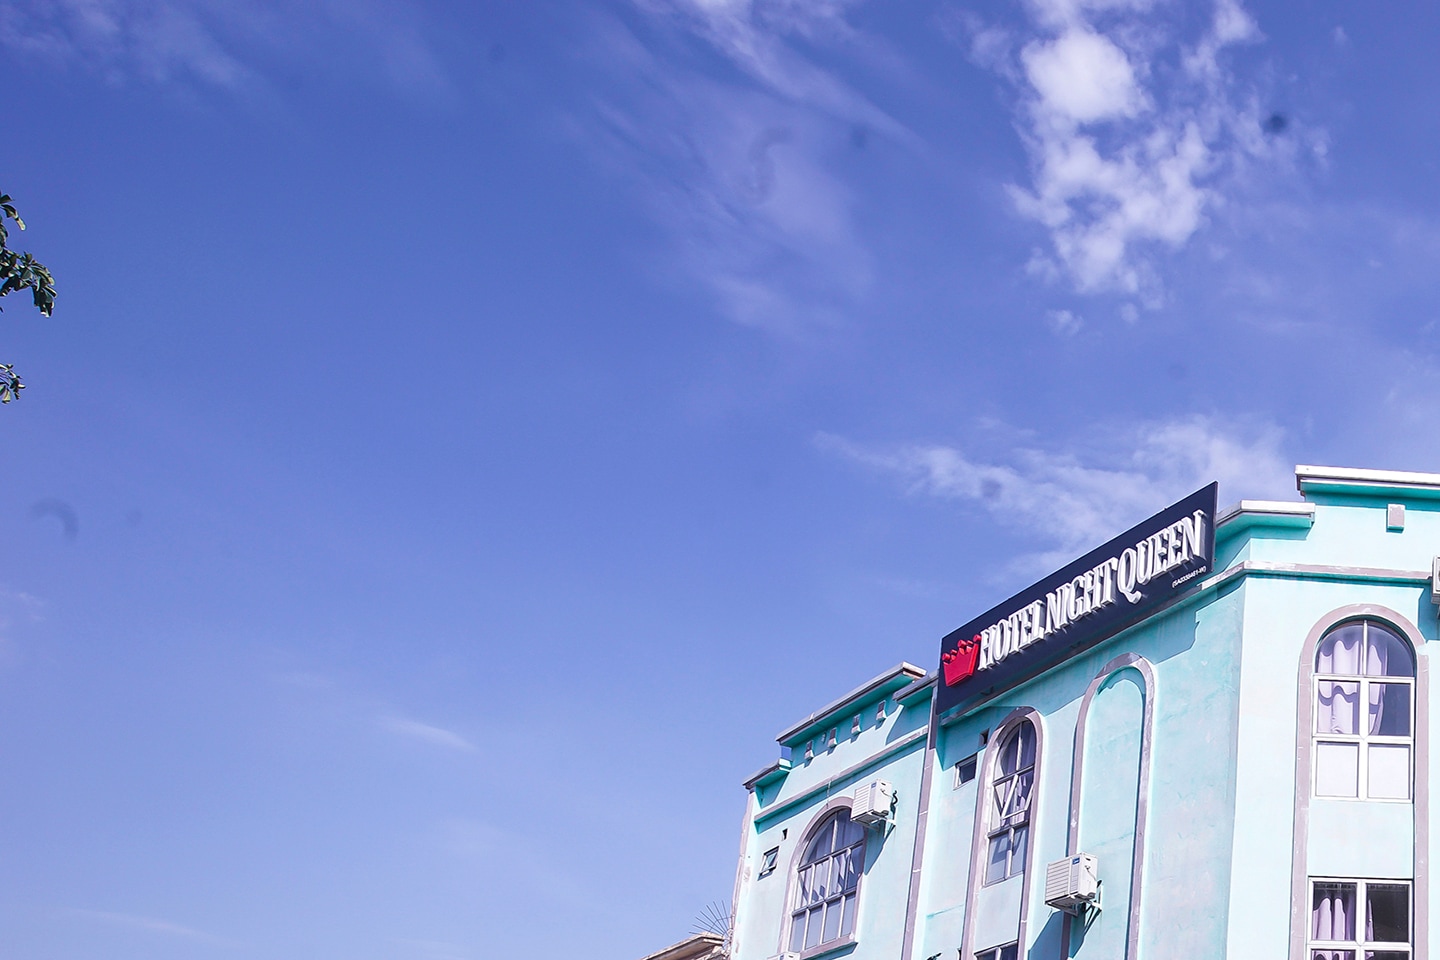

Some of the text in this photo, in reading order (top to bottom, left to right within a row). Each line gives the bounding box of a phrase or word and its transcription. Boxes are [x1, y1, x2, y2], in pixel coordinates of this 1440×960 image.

[977, 509, 1208, 672] HOTEL NIGHT QUEEN
